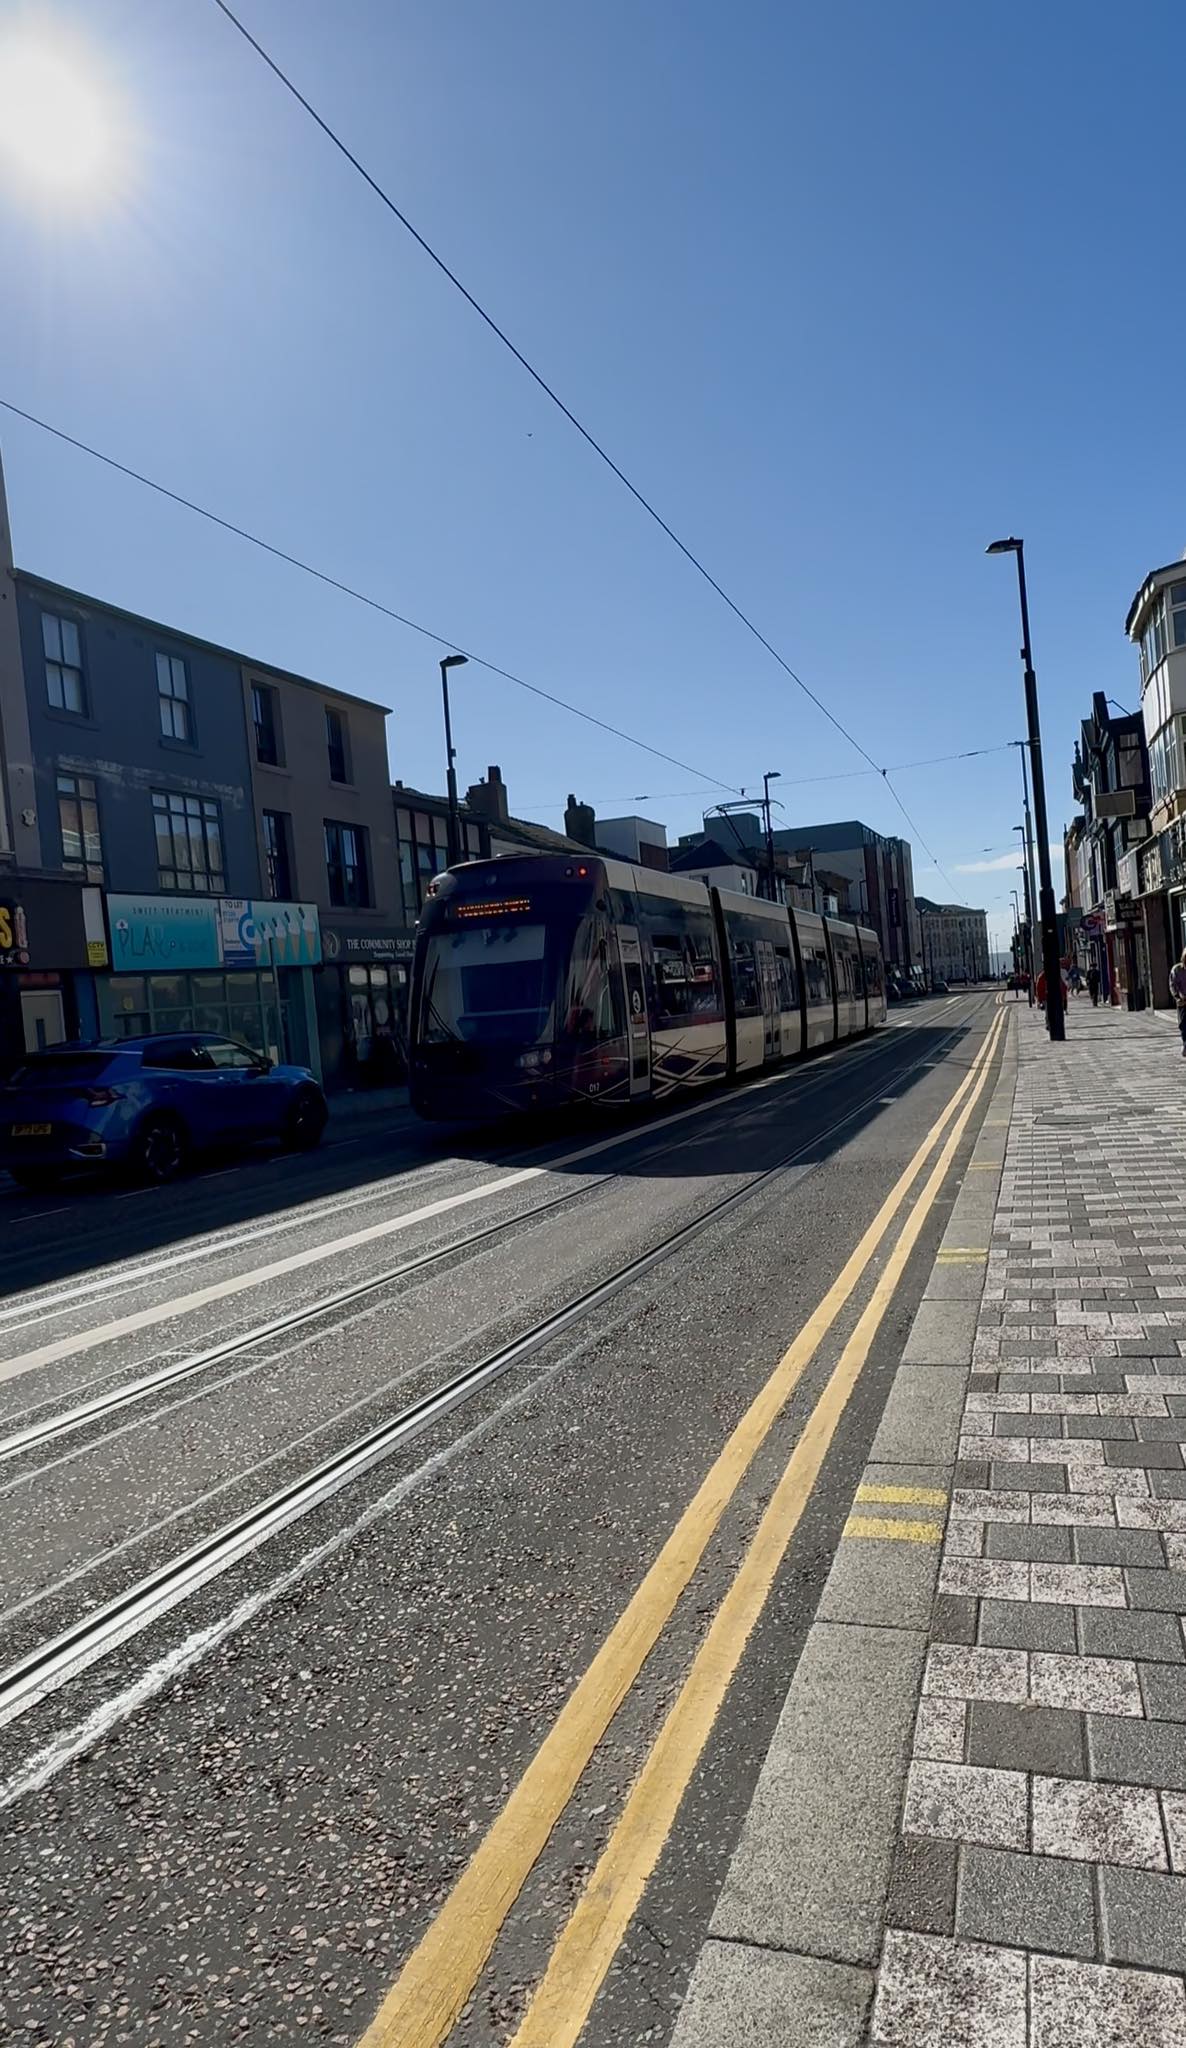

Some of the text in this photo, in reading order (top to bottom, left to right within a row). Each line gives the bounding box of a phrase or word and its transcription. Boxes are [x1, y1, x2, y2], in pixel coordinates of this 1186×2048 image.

[224, 900, 243, 909] TO LET
[132, 906, 204, 916] SWEET TREATMENT
[346, 938, 360, 949] THE
[360, 938, 395, 950] COMMUNITY
[396, 939, 411, 950] SHOP
